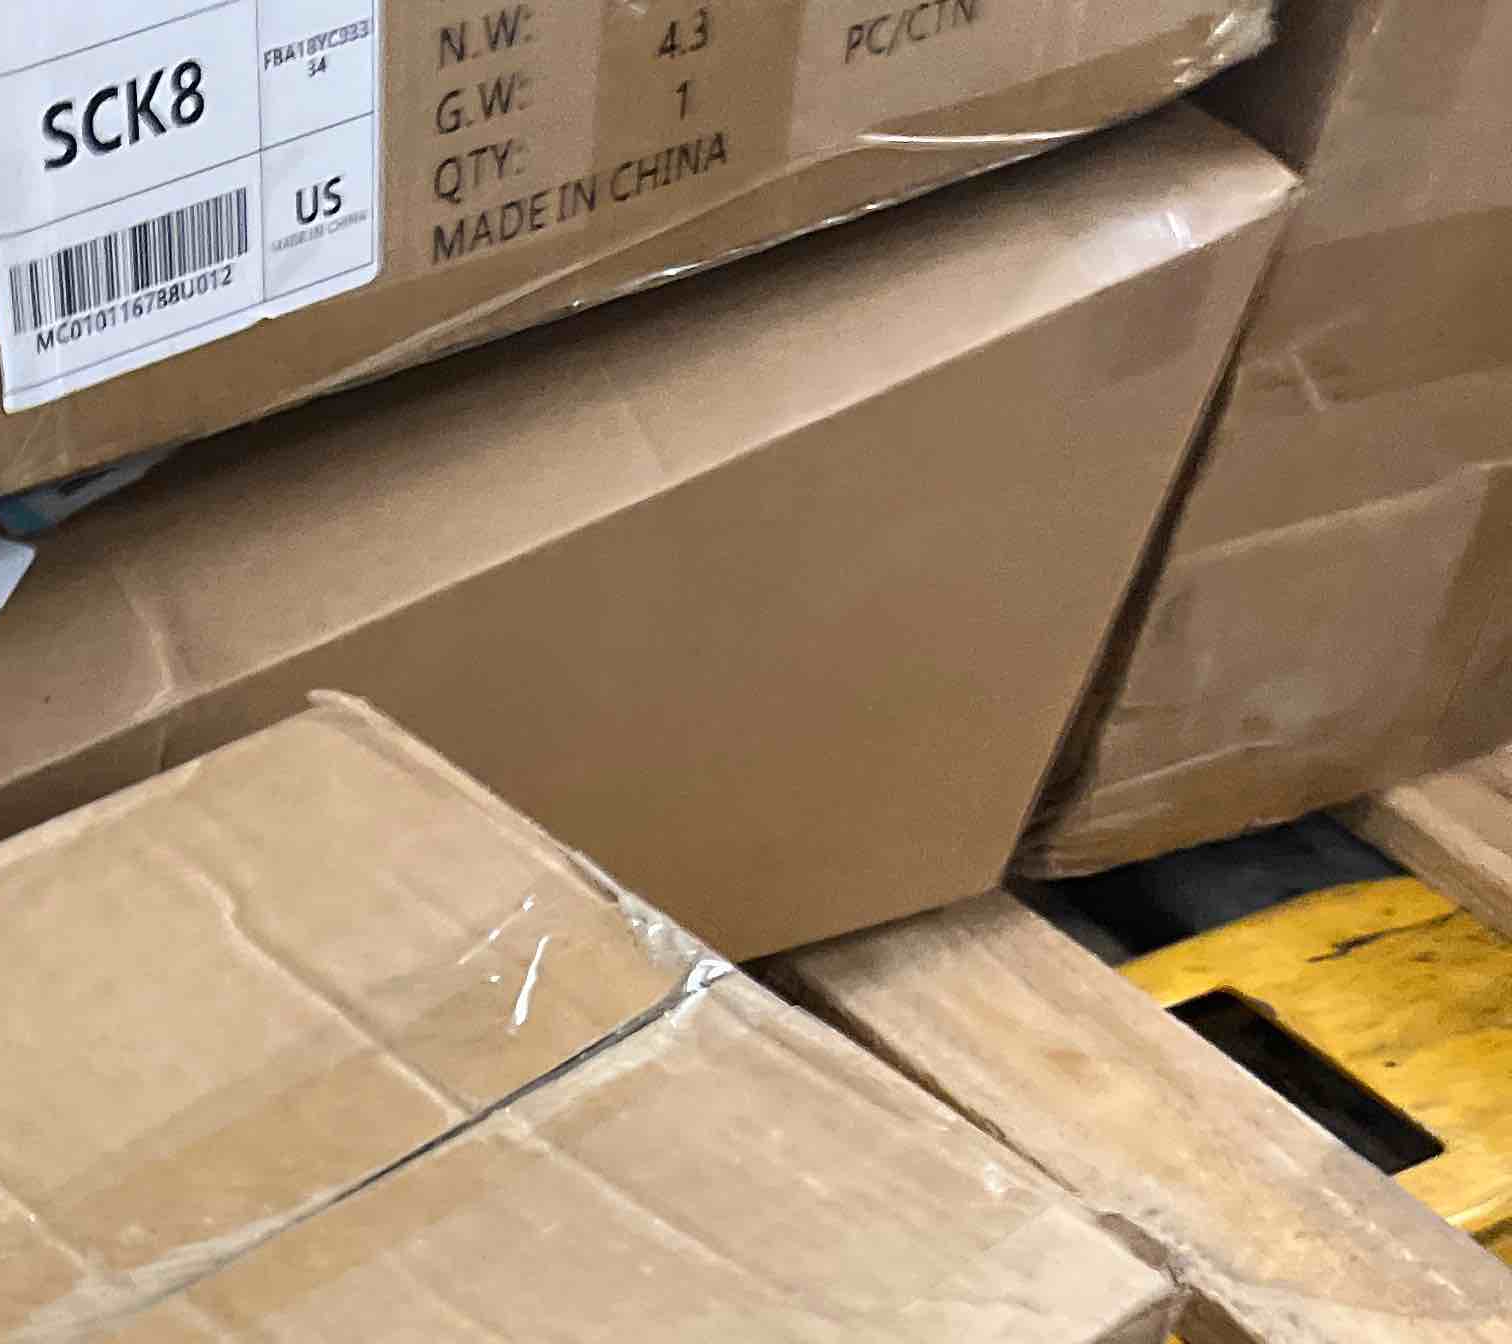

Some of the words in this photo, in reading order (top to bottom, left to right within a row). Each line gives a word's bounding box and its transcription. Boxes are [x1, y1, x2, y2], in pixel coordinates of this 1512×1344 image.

[845, 0, 977, 64] PC/CTN
[42, 60, 205, 170] SCK8
[675, 79, 691, 120] 1
[295, 175, 342, 225] US
[432, 189, 551, 266] MADE
[556, 176, 598, 223] IN
[609, 131, 728, 202] CHINA
[434, 138, 526, 204] QTY:
